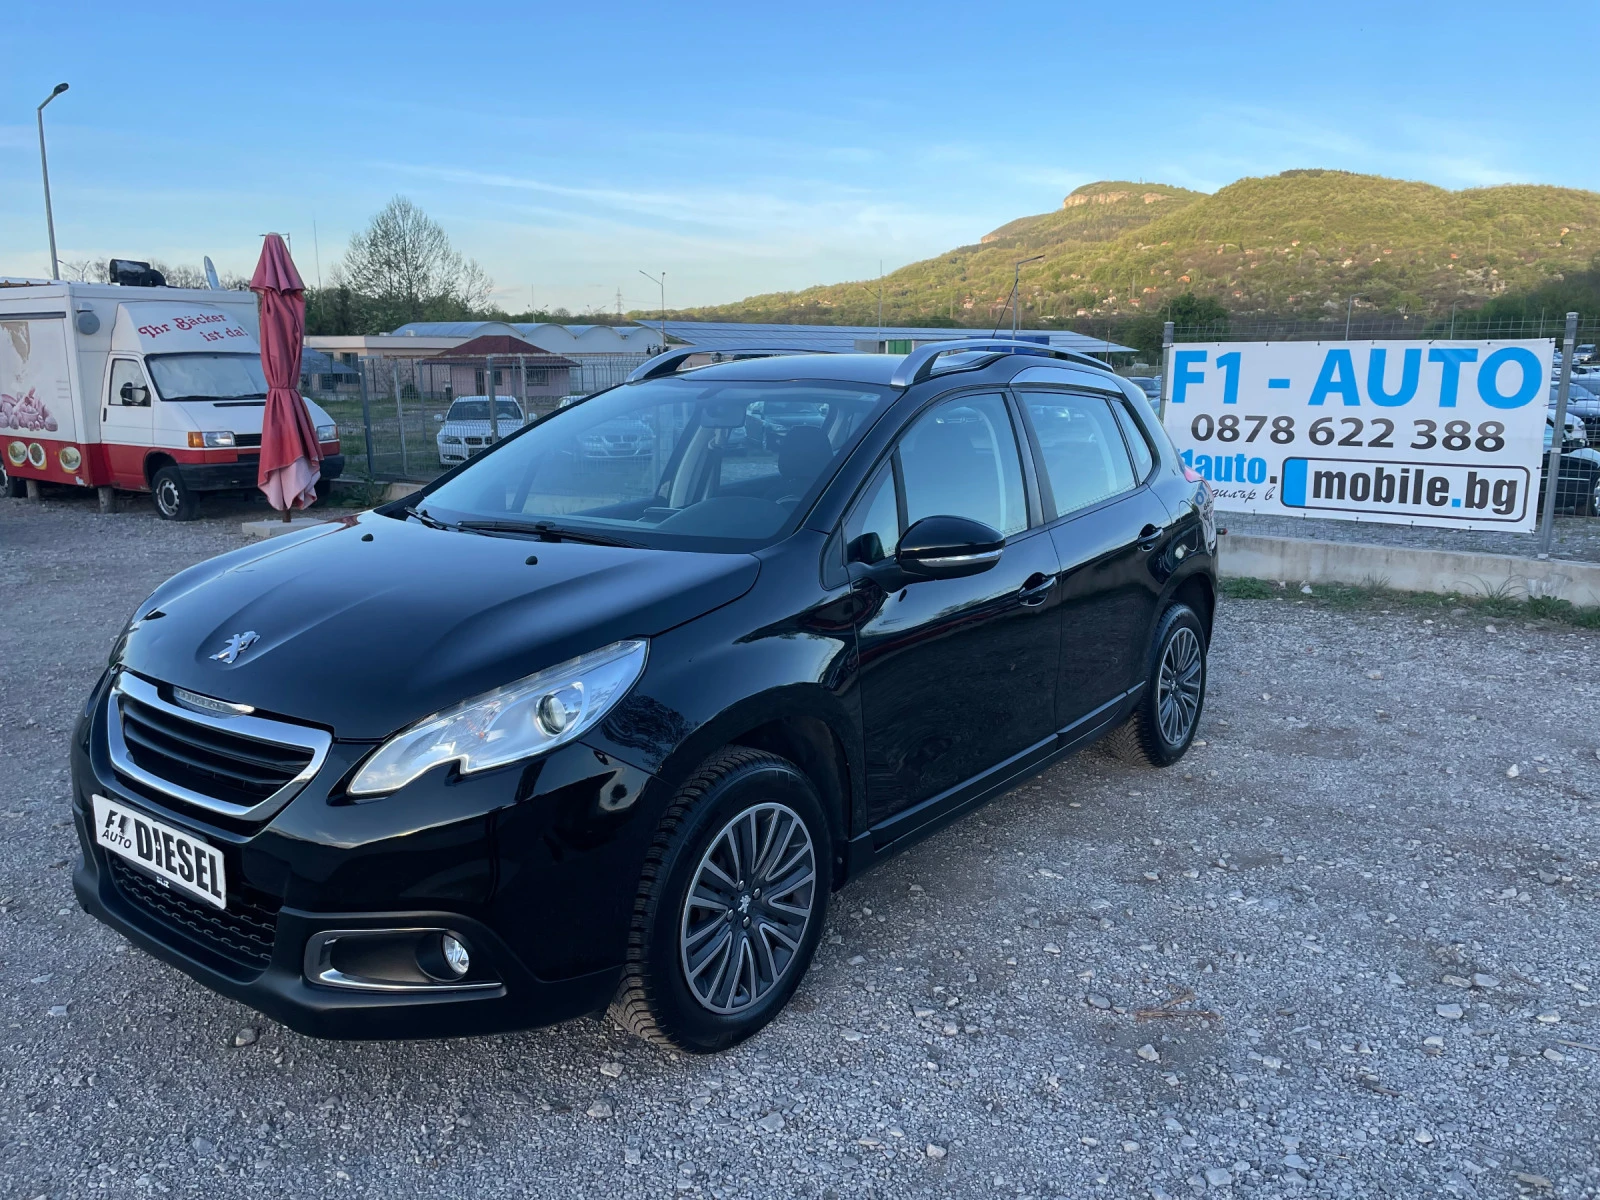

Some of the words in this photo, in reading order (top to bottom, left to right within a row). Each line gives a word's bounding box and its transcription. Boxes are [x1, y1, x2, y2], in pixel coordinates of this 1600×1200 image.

[138, 324, 171, 338] Ihr
[172, 313, 227, 331] Bäcker
[200, 330, 225, 342] ist
[225, 325, 249, 338] da!
[1171, 350, 1242, 405] F1
[1308, 347, 1543, 411] AUTO
[1191, 413, 1296, 445] 0878
[1308, 416, 1395, 449] 622
[1410, 419, 1505, 452] 388
[1313, 466, 1518, 516] mobile.bg
[102, 829, 132, 849] AUTO
[133, 818, 222, 900] DIESEL
